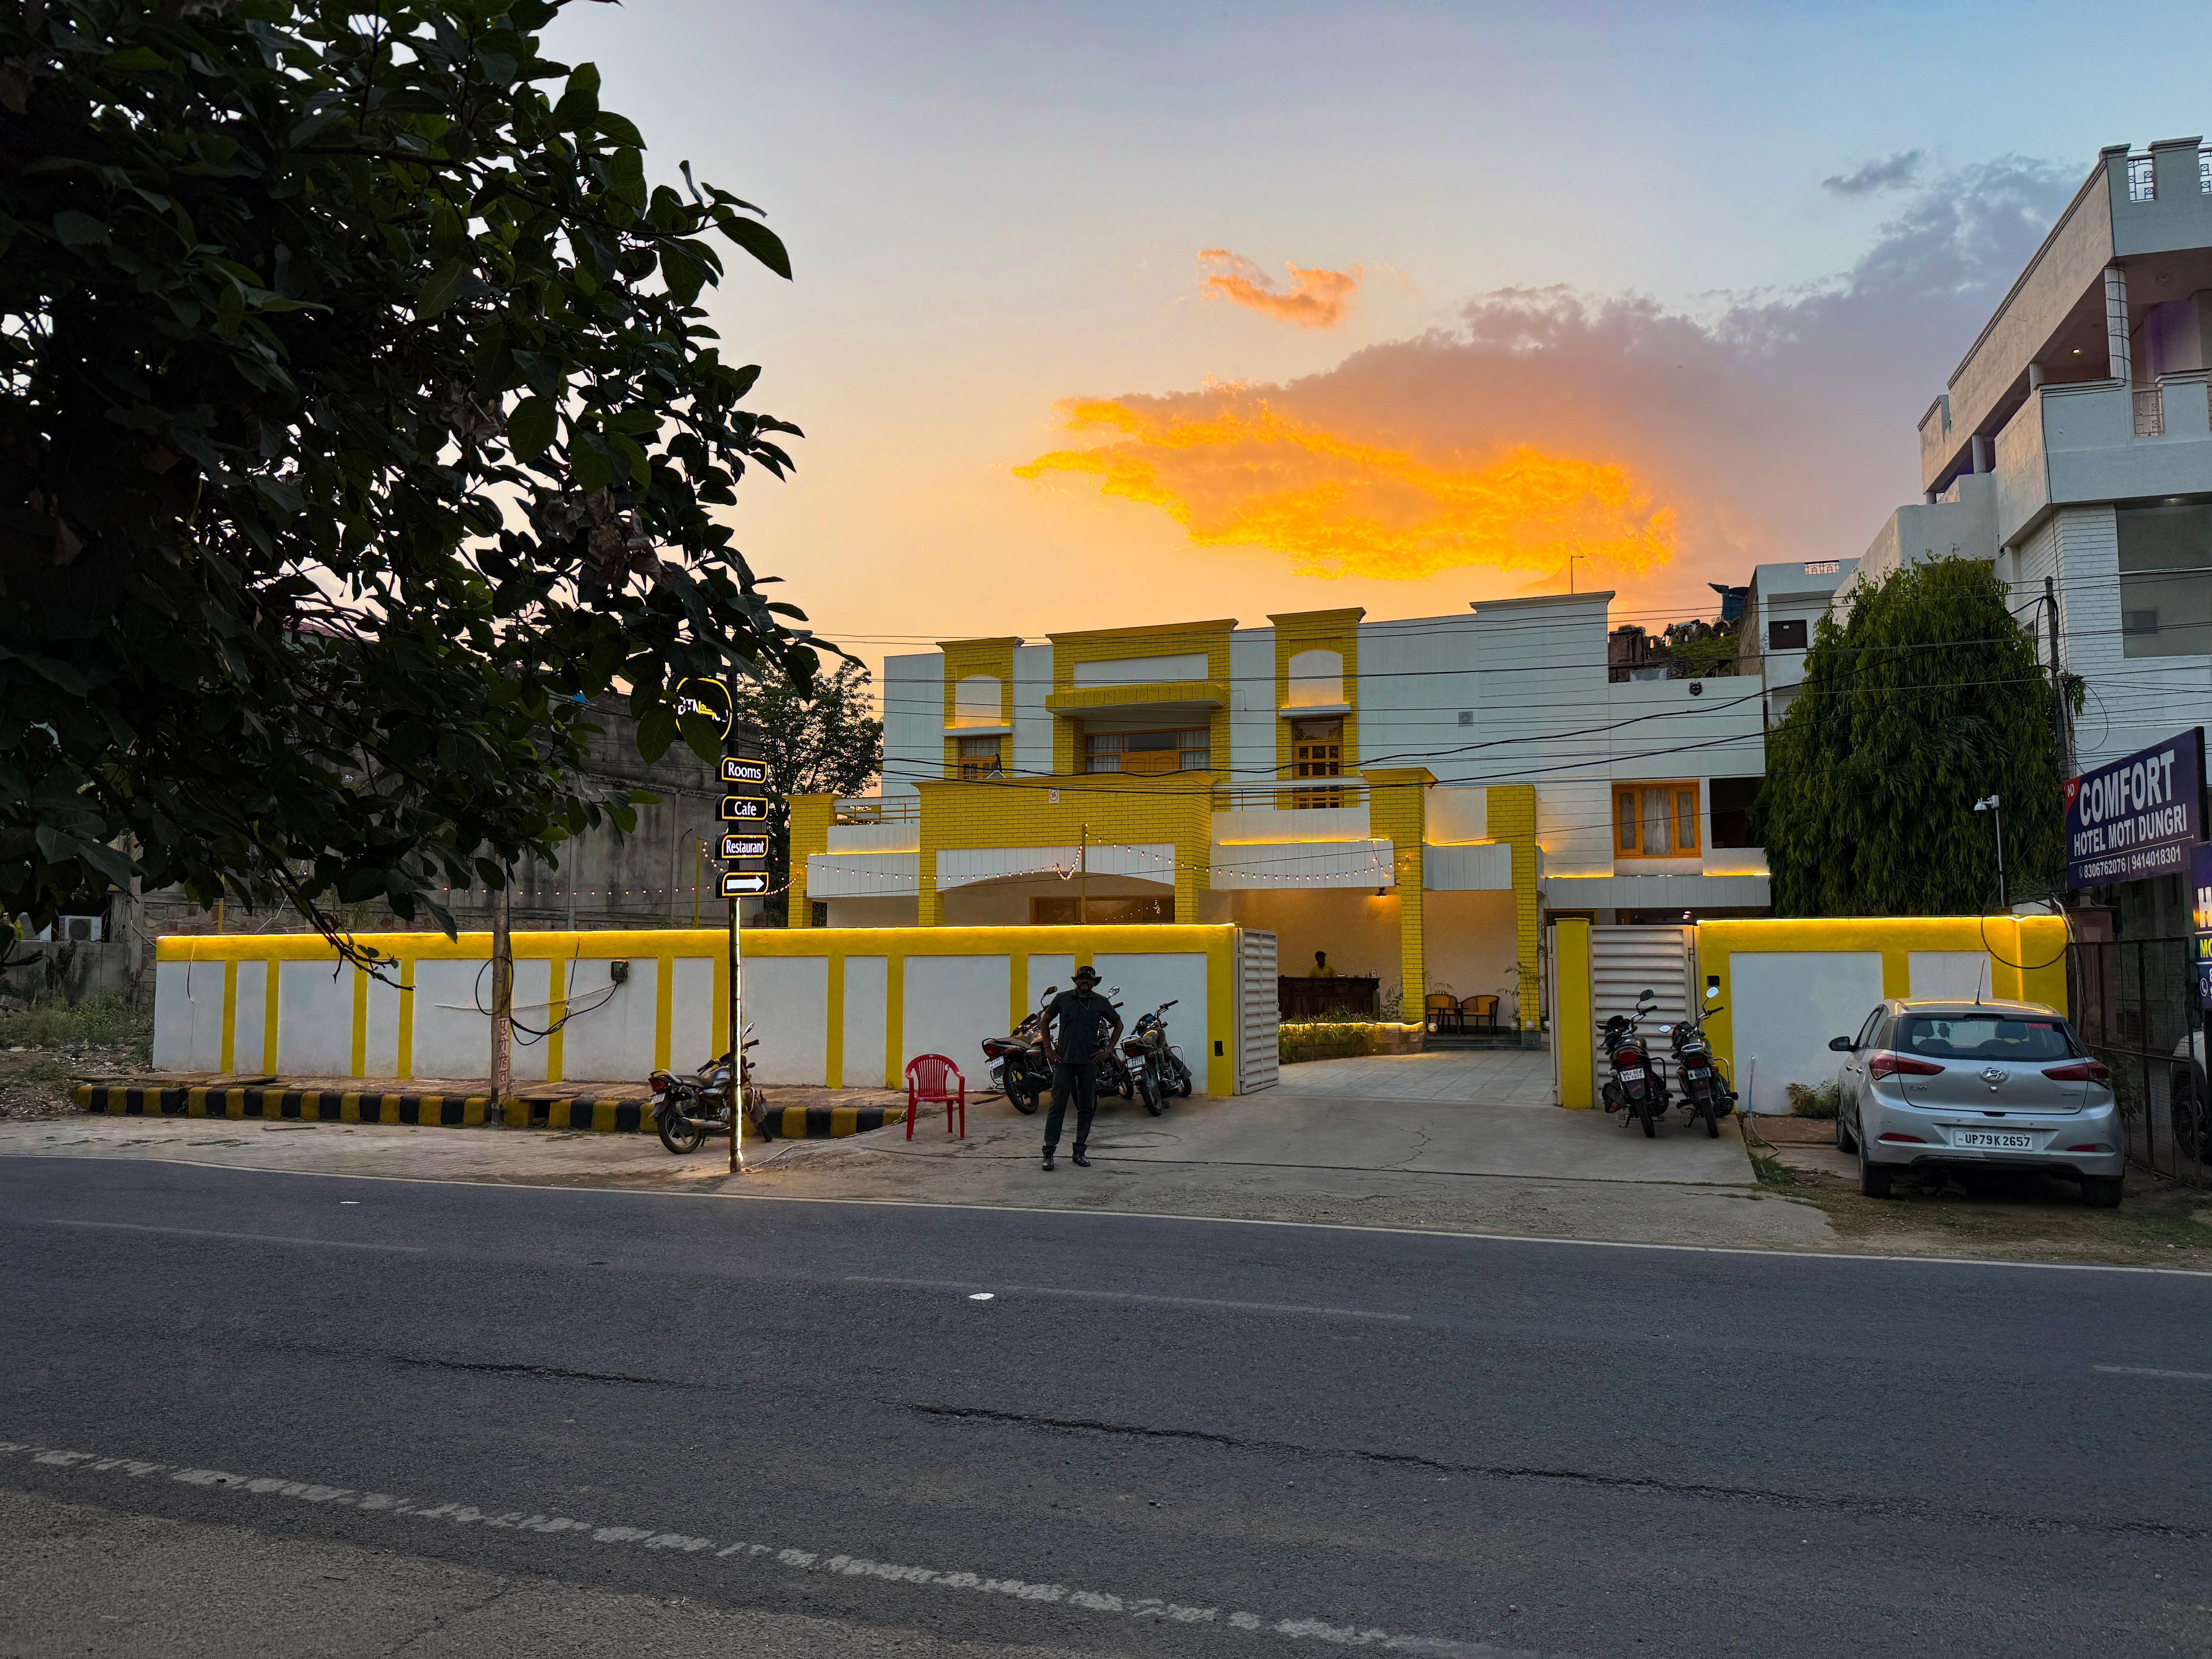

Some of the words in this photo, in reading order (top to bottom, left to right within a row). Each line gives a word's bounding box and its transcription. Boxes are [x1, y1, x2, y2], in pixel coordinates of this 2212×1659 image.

[728, 761, 761, 779] Rooms
[2067, 784, 2074, 797] MD
[2079, 749, 2175, 826] COMFORT
[734, 801, 757, 816] Cafe
[2074, 827, 2105, 857] HOTEL
[2108, 818, 2135, 849] MOTI
[2139, 803, 2187, 842] DUNGRI
[726, 839, 764, 854] Restaurant
[2084, 857, 2126, 879] 8306762076
[2131, 845, 2181, 870] 9414018301
[1965, 1134, 1992, 1144] UP79
[1994, 1135, 2000, 1146] K
[2003, 1136, 2030, 1147] 2657
